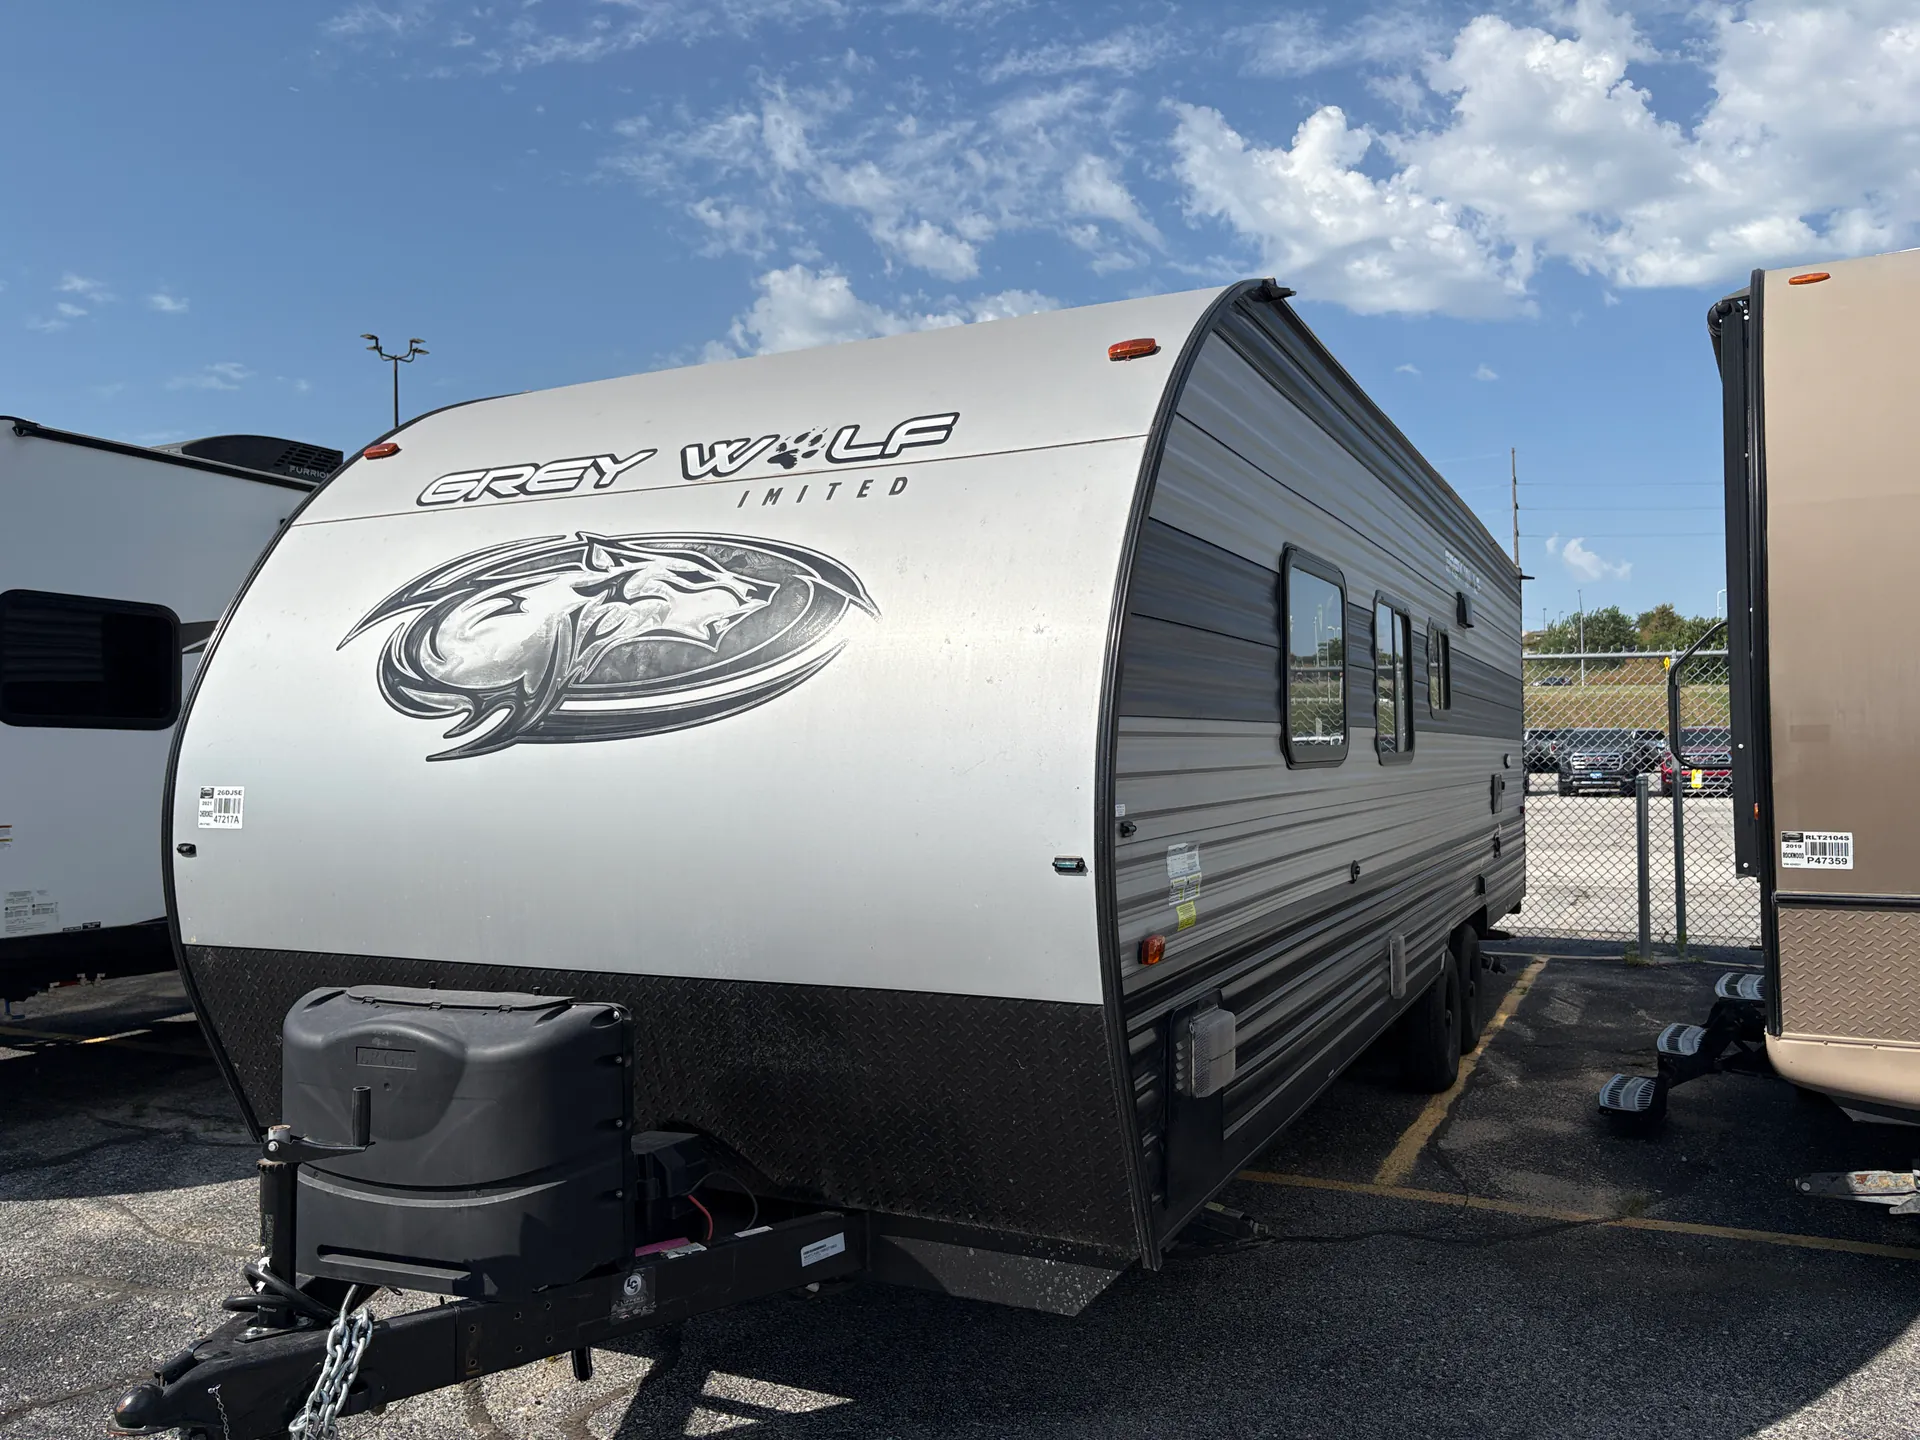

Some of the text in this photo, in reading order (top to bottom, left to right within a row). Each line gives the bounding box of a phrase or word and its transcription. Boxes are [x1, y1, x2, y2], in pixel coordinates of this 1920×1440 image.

[416, 448, 658, 506] GREY
[213, 815, 239, 824] 47217A
[1807, 856, 1848, 865] P47359
